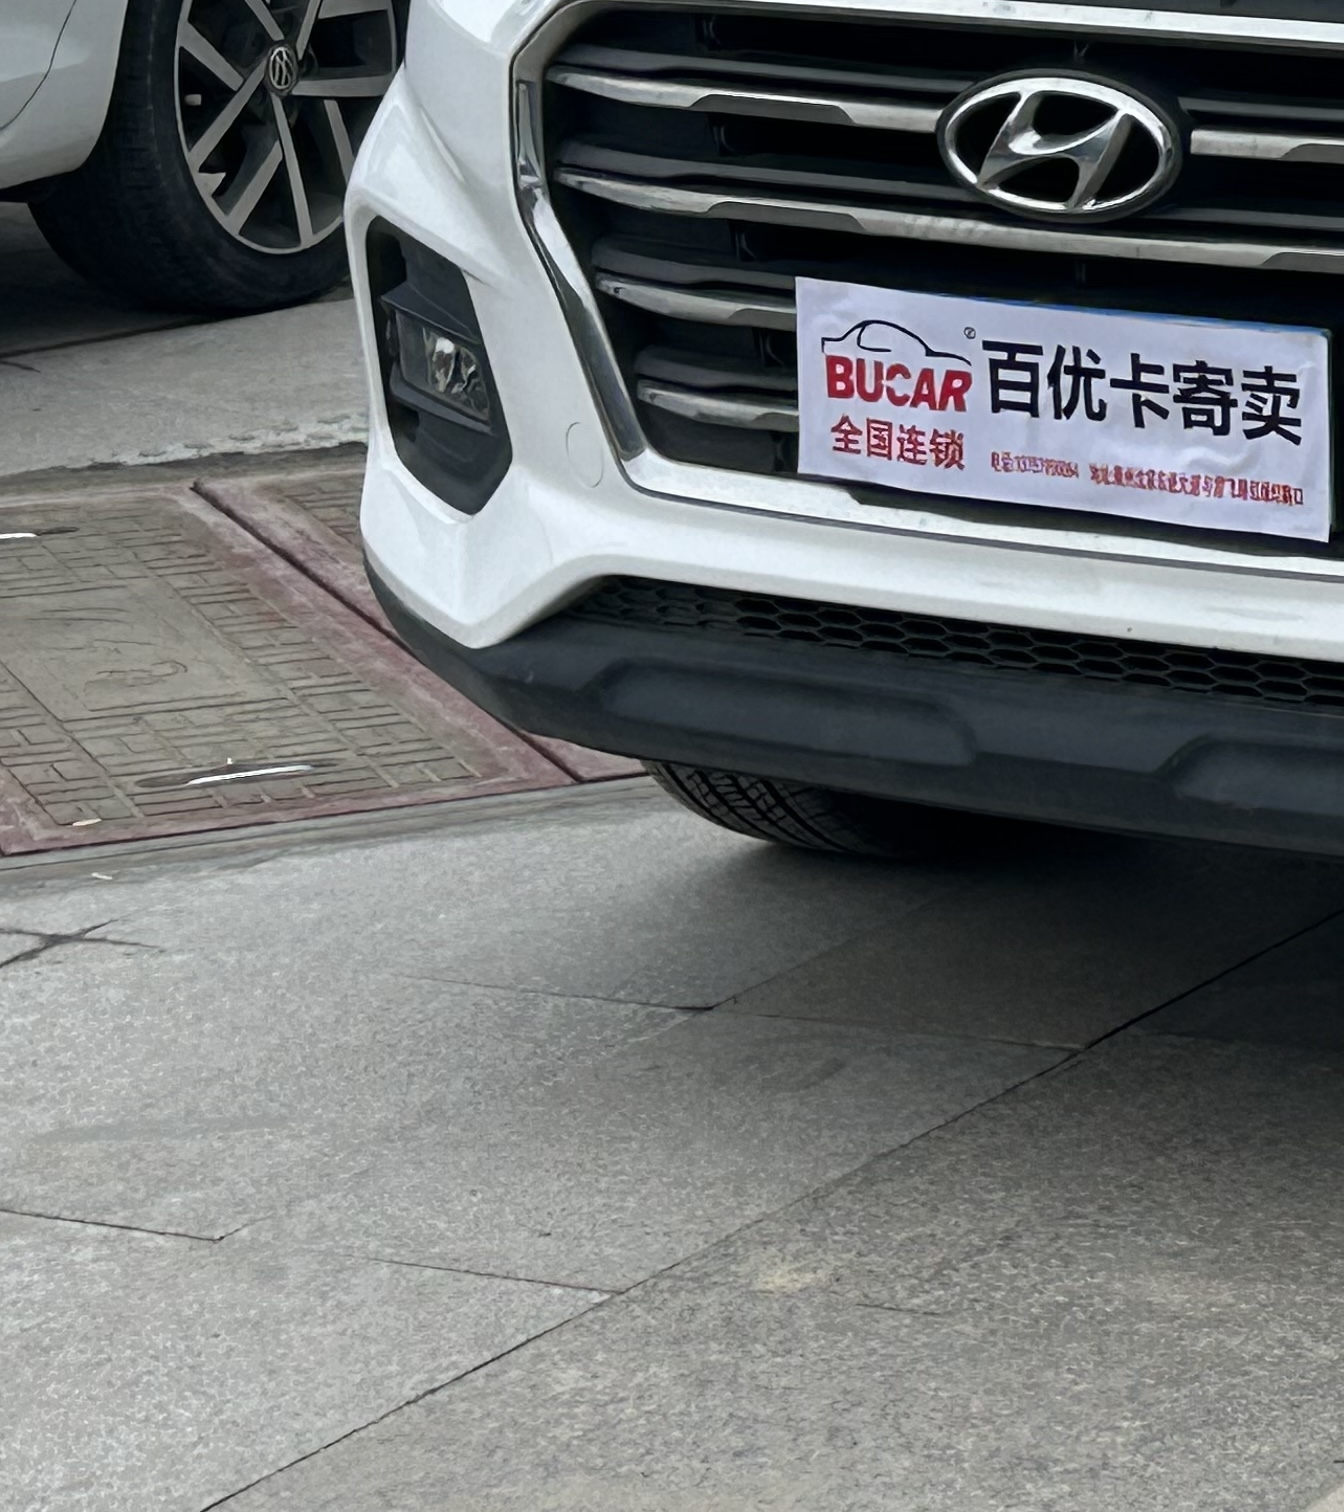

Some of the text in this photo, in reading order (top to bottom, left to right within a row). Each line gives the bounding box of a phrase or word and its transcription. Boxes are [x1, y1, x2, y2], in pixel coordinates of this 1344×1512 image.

[824, 354, 973, 412] BUCAR
[982, 340, 1303, 445] 百优卡寄卖
[830, 414, 966, 471] 全国连锁
